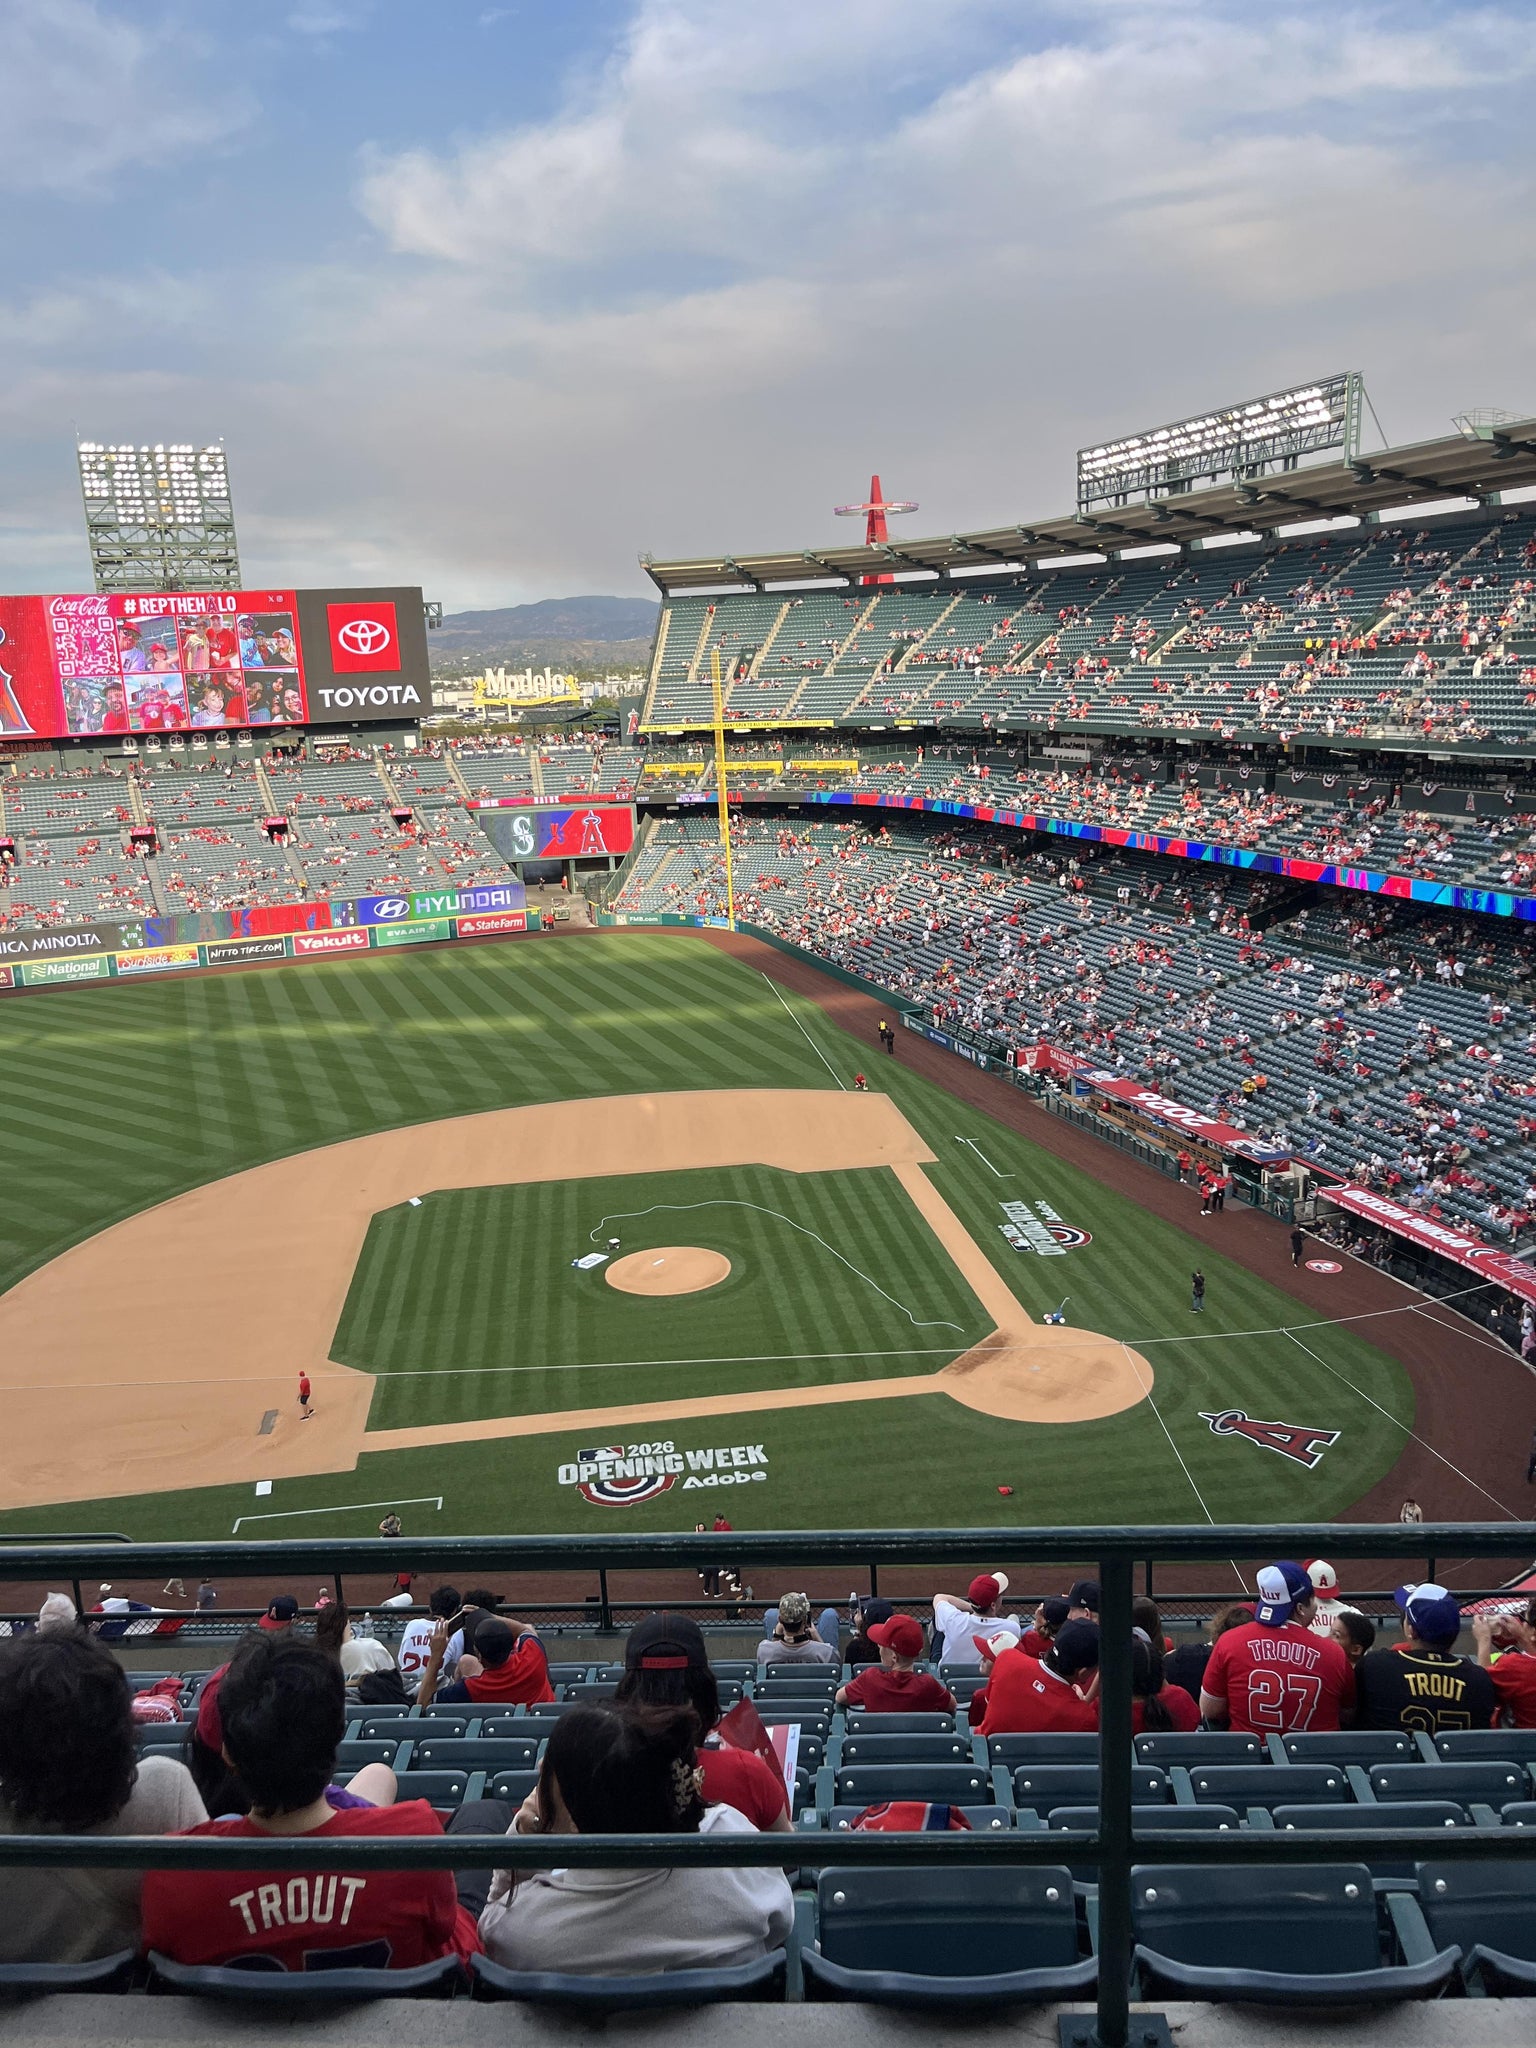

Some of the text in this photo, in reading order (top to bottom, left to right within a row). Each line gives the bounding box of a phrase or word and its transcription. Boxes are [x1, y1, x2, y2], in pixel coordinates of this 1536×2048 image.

[124, 600, 136, 613] #
[485, 667, 565, 697] Modelo
[318, 685, 421, 708] TOYOTA
[148, 738, 159, 746] 26
[416, 889, 511, 914] HYUNDAI
[298, 932, 364, 949] Yakult
[386, 927, 425, 937] EVA AIR
[33, 933, 101, 951] MINOLTA
[210, 942, 283, 959] NITTO TIRE.COM
[47, 960, 100, 975] National
[121, 954, 169, 969] Surfside
[1130, 1092, 1218, 1127] 2026
[628, 1441, 675, 1457] 2026
[558, 1445, 768, 1484] OPENING WEEK
[682, 1470, 767, 1489] Adobe
[1248, 1639, 1320, 1669] TROUT
[1404, 1672, 1466, 1701] TROUT
[1248, 1670, 1321, 1731] 27
[229, 1875, 366, 1934] TROUT
